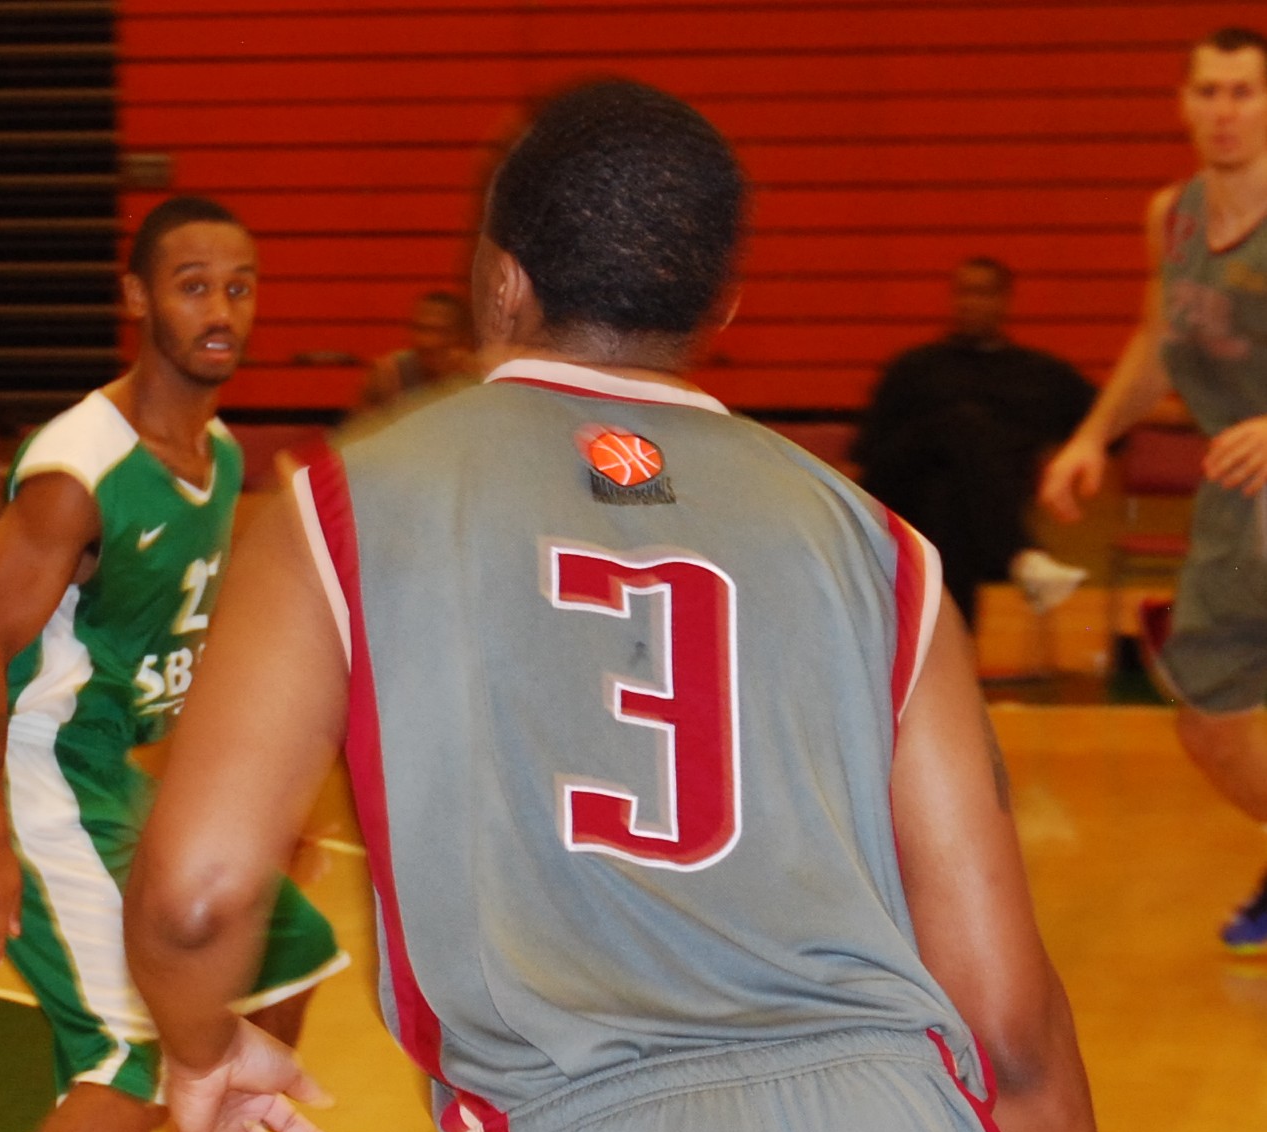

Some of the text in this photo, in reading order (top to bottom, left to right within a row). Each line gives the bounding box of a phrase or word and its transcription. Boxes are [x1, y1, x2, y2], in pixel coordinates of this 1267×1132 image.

[171, 551, 222, 634] 2
[134, 644, 206, 700] SB
[550, 546, 742, 872] 3
